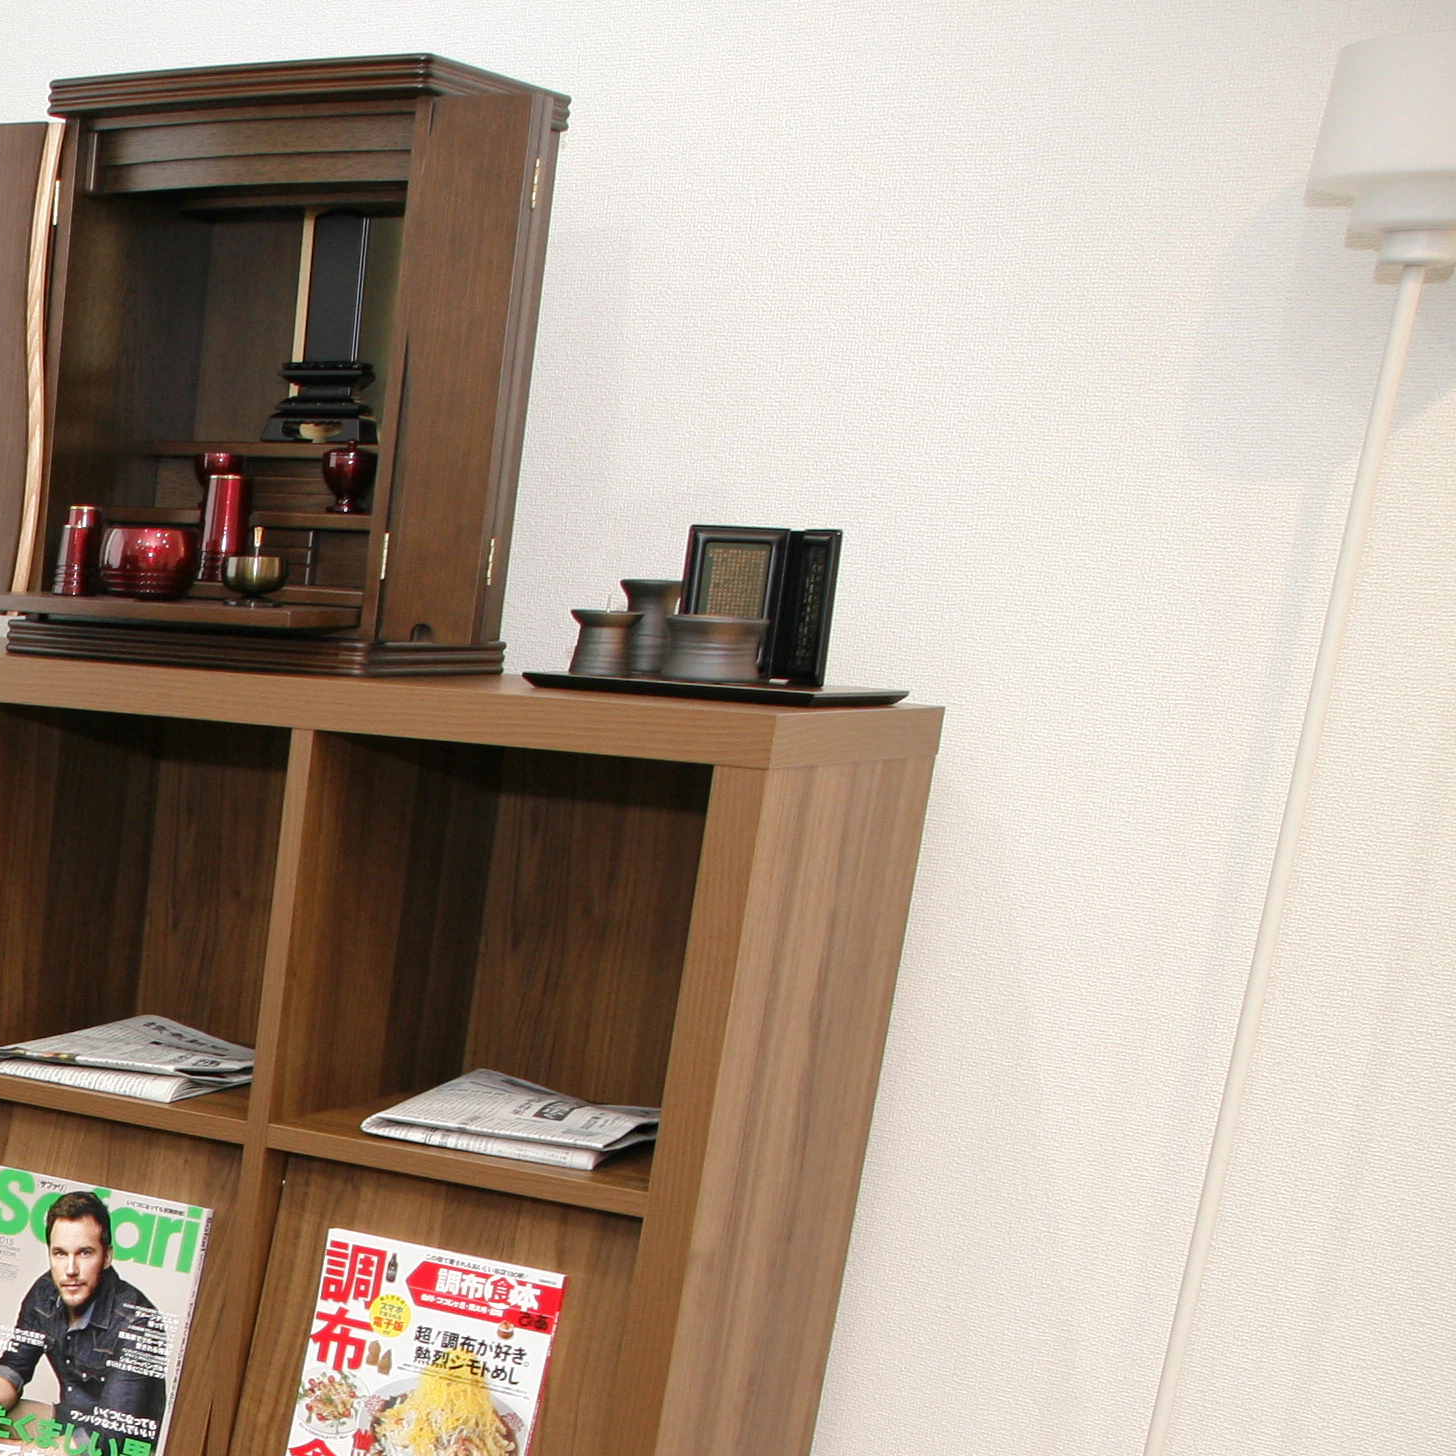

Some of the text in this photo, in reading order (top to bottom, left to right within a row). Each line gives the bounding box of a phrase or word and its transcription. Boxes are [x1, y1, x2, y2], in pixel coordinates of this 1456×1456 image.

[310, 1240, 387, 1372] 調布
[373, 1316, 405, 1332] 電子版
[413, 1346, 521, 1385] 熱烈ジモトめし
[414, 1325, 530, 1368] 超!調布が好き。
[93, 1406, 157, 1430] いくつになっても
